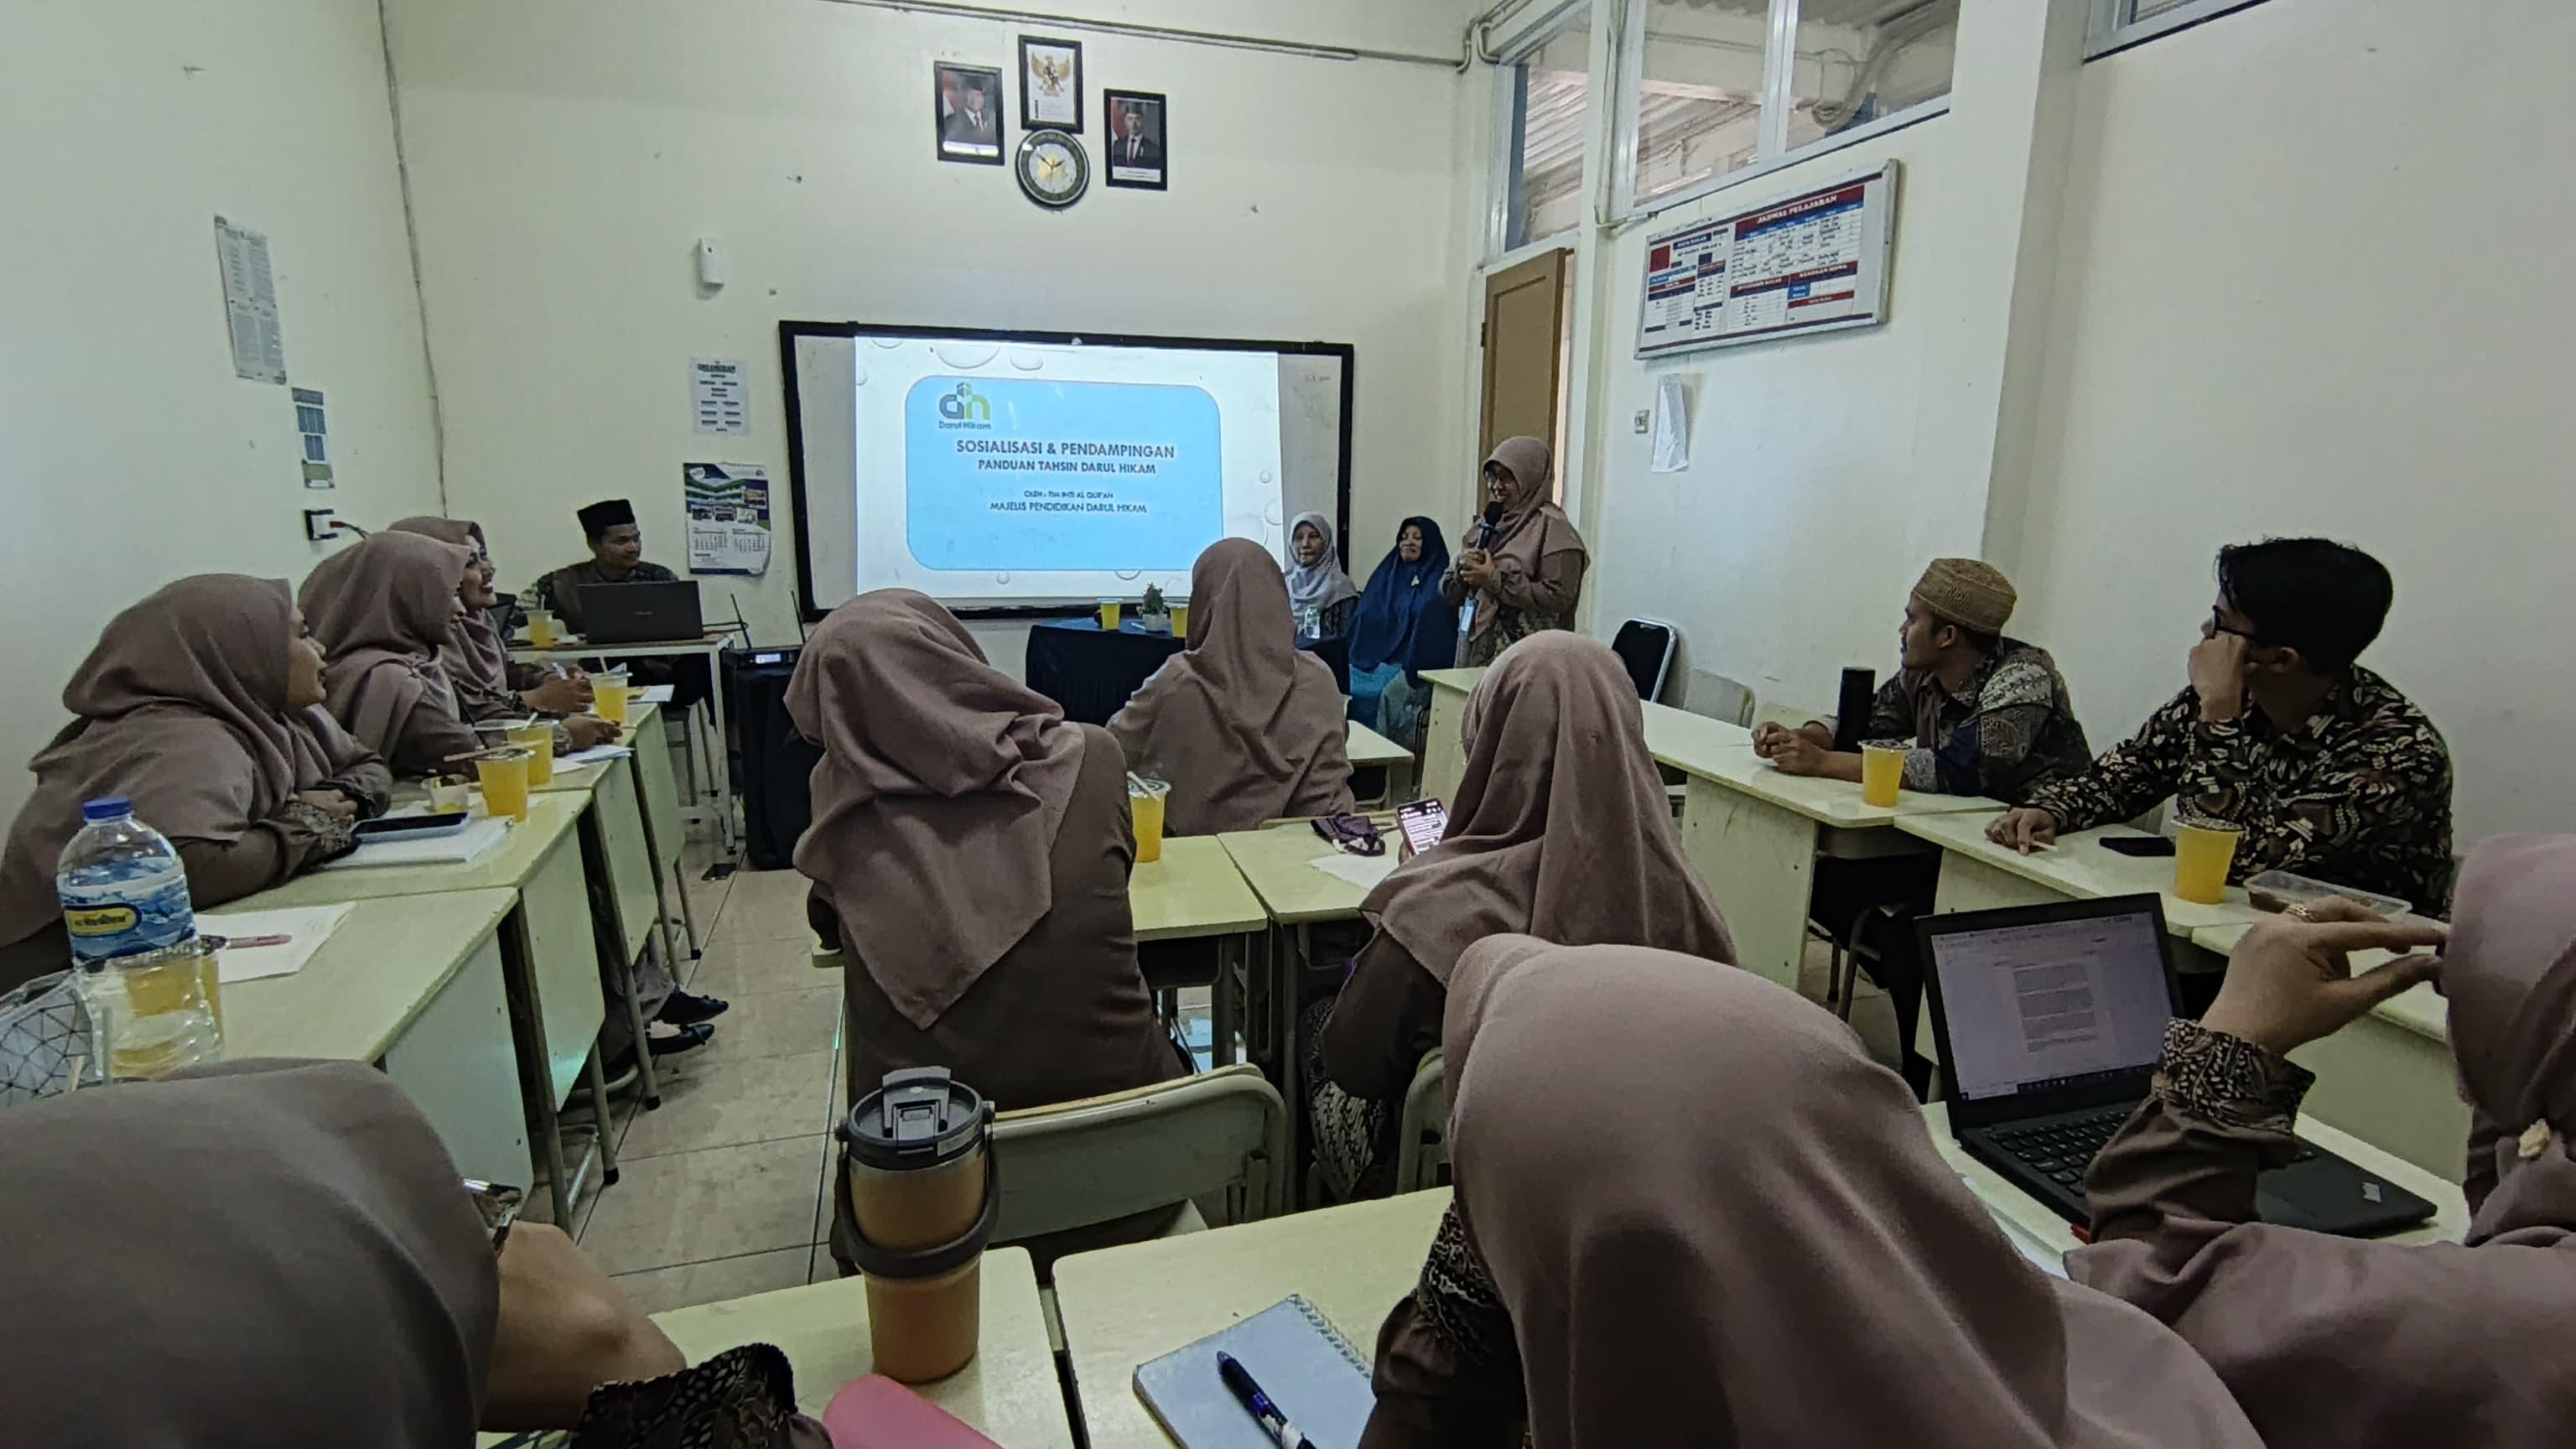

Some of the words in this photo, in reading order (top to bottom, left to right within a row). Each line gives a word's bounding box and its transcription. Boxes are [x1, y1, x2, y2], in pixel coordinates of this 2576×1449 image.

[1789, 195, 1837, 215] PELAJARAN
[939, 421, 962, 429] Darul
[957, 439, 1042, 454] SOSIALISASI
[1046, 442, 1057, 454] &
[1062, 443, 1175, 459] PENDAMPINGAN
[979, 460, 1036, 470] PANDUAN
[1038, 460, 1078, 472] TAHSIN
[1081, 462, 1116, 473] DARUL
[1119, 464, 1156, 475] HIKAM
[989, 502, 1026, 511] MAJELIS
[1029, 502, 1084, 512] PENDIDIKAN
[1086, 503, 1115, 512] DARUL
[1117, 504, 1147, 513] HIKAM
